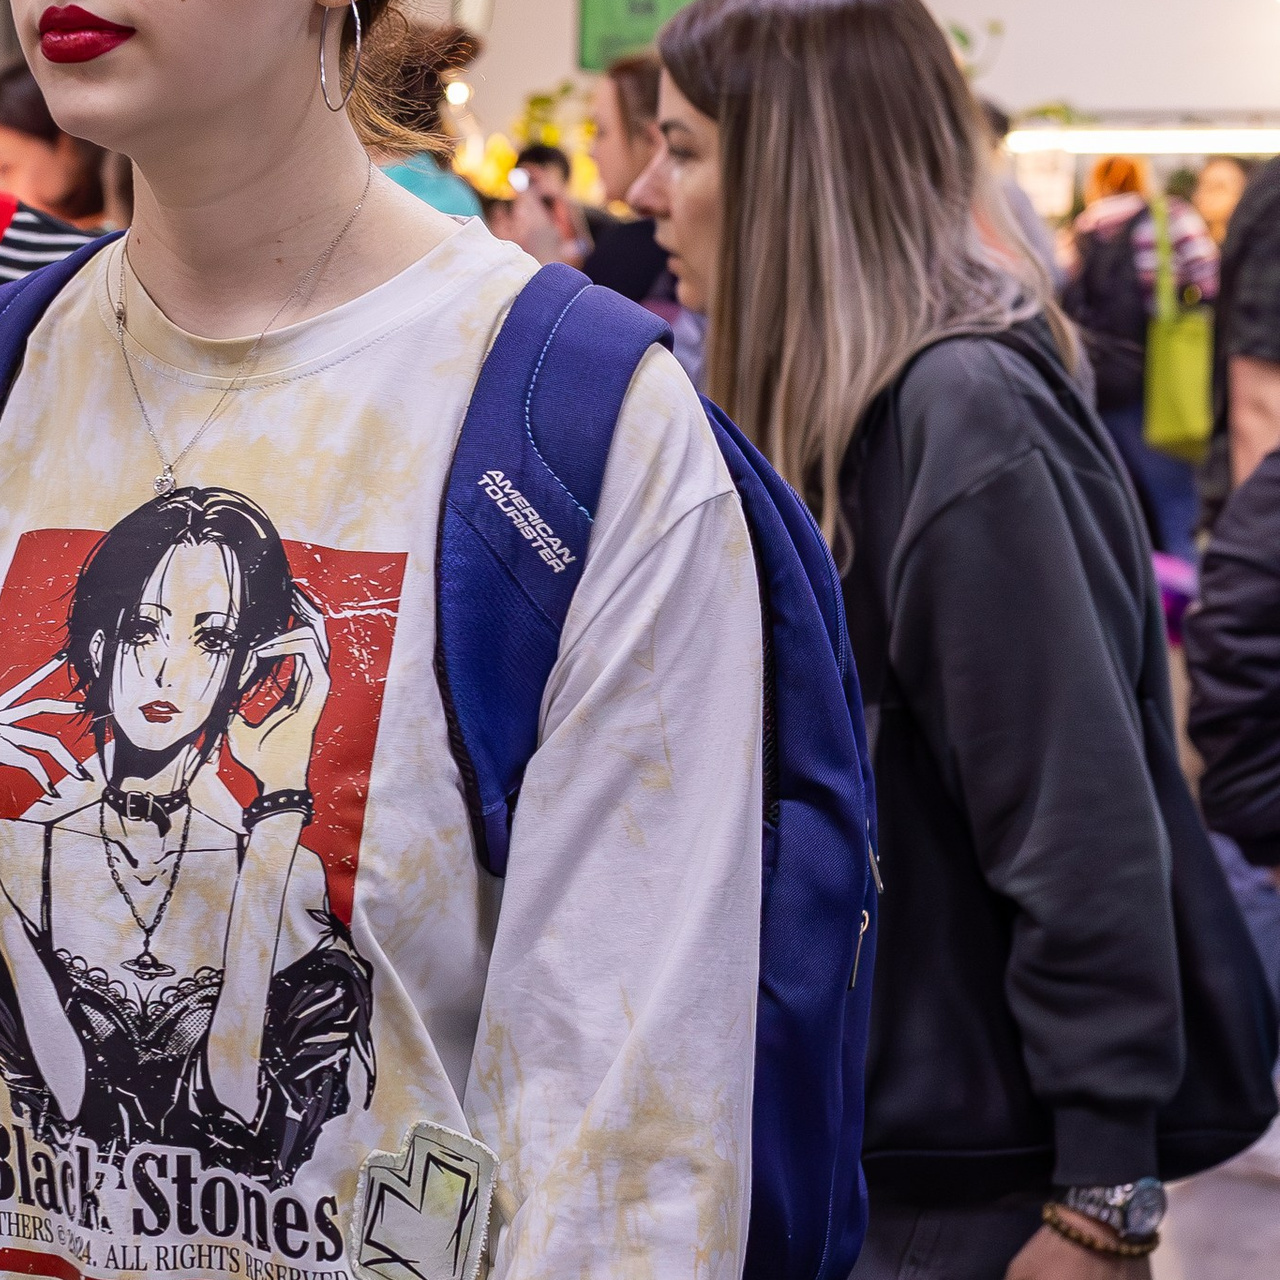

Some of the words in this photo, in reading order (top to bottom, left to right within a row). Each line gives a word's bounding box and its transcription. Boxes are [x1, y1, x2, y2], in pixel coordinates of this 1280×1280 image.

[477, 474, 566, 574] TOURISTER
[485, 470, 577, 564] AMERICAN
[132, 1151, 344, 1263] Stones
[104, 1244, 149, 1272] ALL
[155, 1243, 241, 1274] RIGHTS
